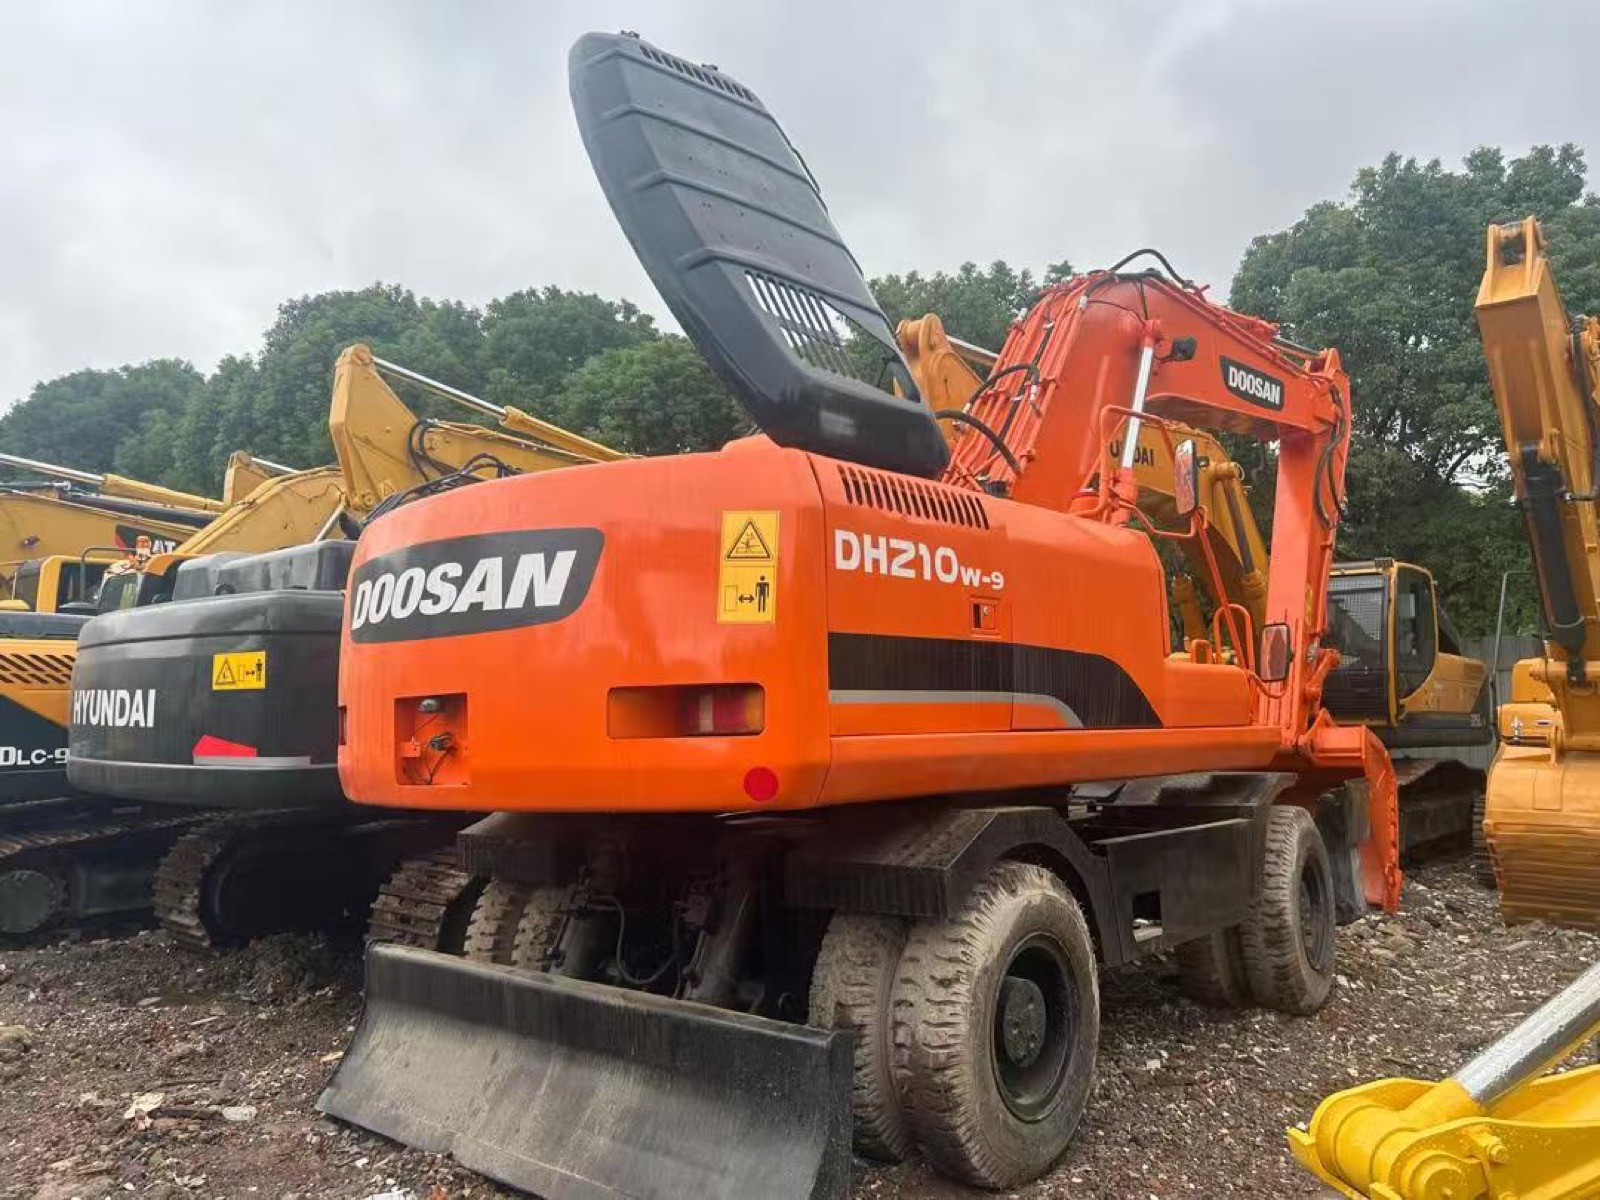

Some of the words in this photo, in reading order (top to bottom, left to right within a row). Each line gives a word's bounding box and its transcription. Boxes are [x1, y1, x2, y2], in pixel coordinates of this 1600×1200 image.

[1228, 365, 1281, 405] DOOSAN
[152, 539, 176, 554] AT
[351, 550, 577, 631] DOOSAN
[73, 688, 156, 728] HYUNDAI
